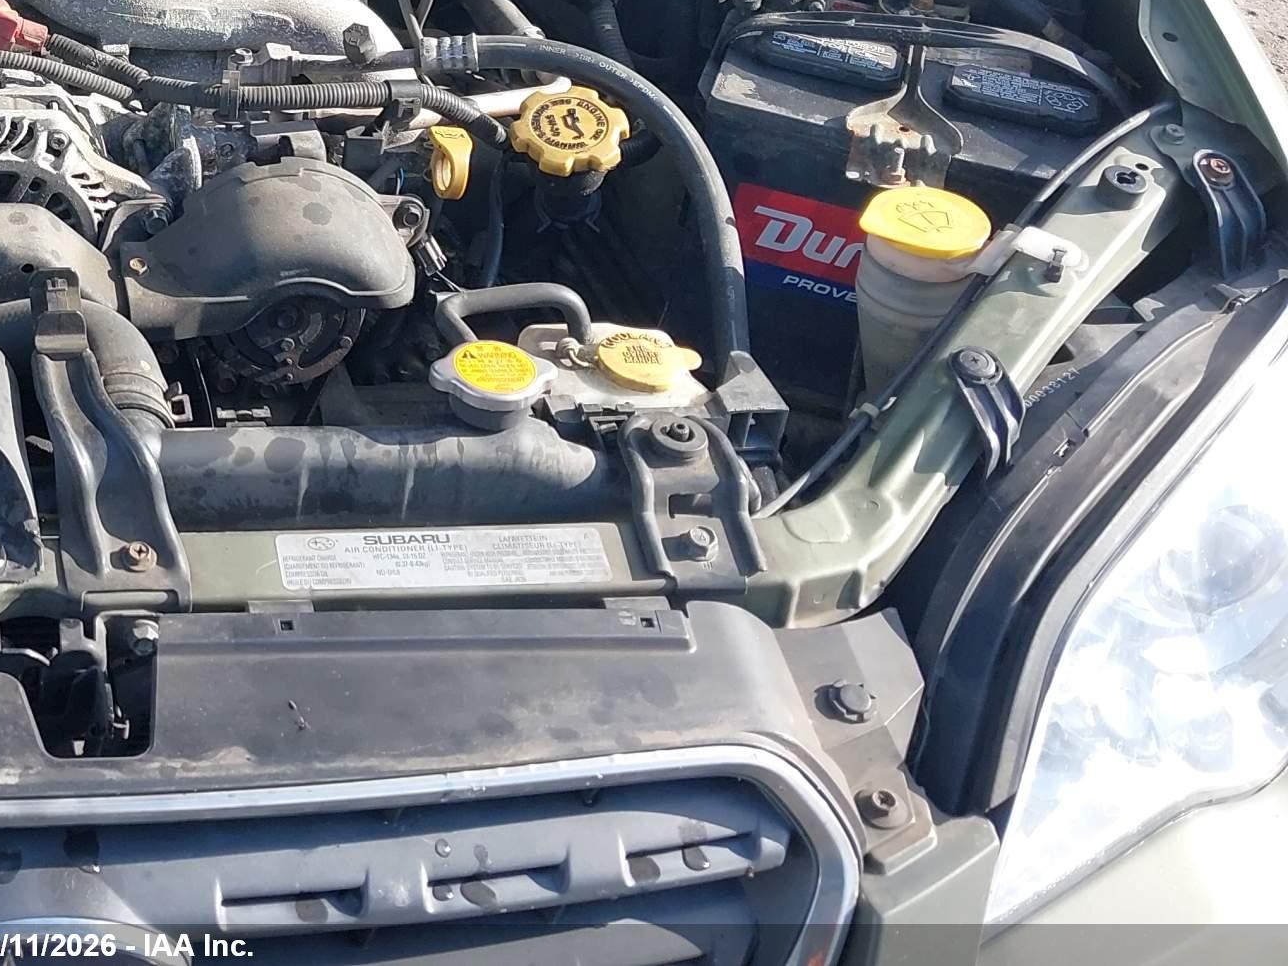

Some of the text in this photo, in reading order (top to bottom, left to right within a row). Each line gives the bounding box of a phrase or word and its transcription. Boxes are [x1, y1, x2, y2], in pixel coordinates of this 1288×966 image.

[599, 61, 628, 79] OUTER
[576, 100, 605, 127] ENGINE
[363, 534, 450, 545] SUBARU
[344, 546, 361, 554] AIR
[362, 545, 425, 554] CONDITIONER
